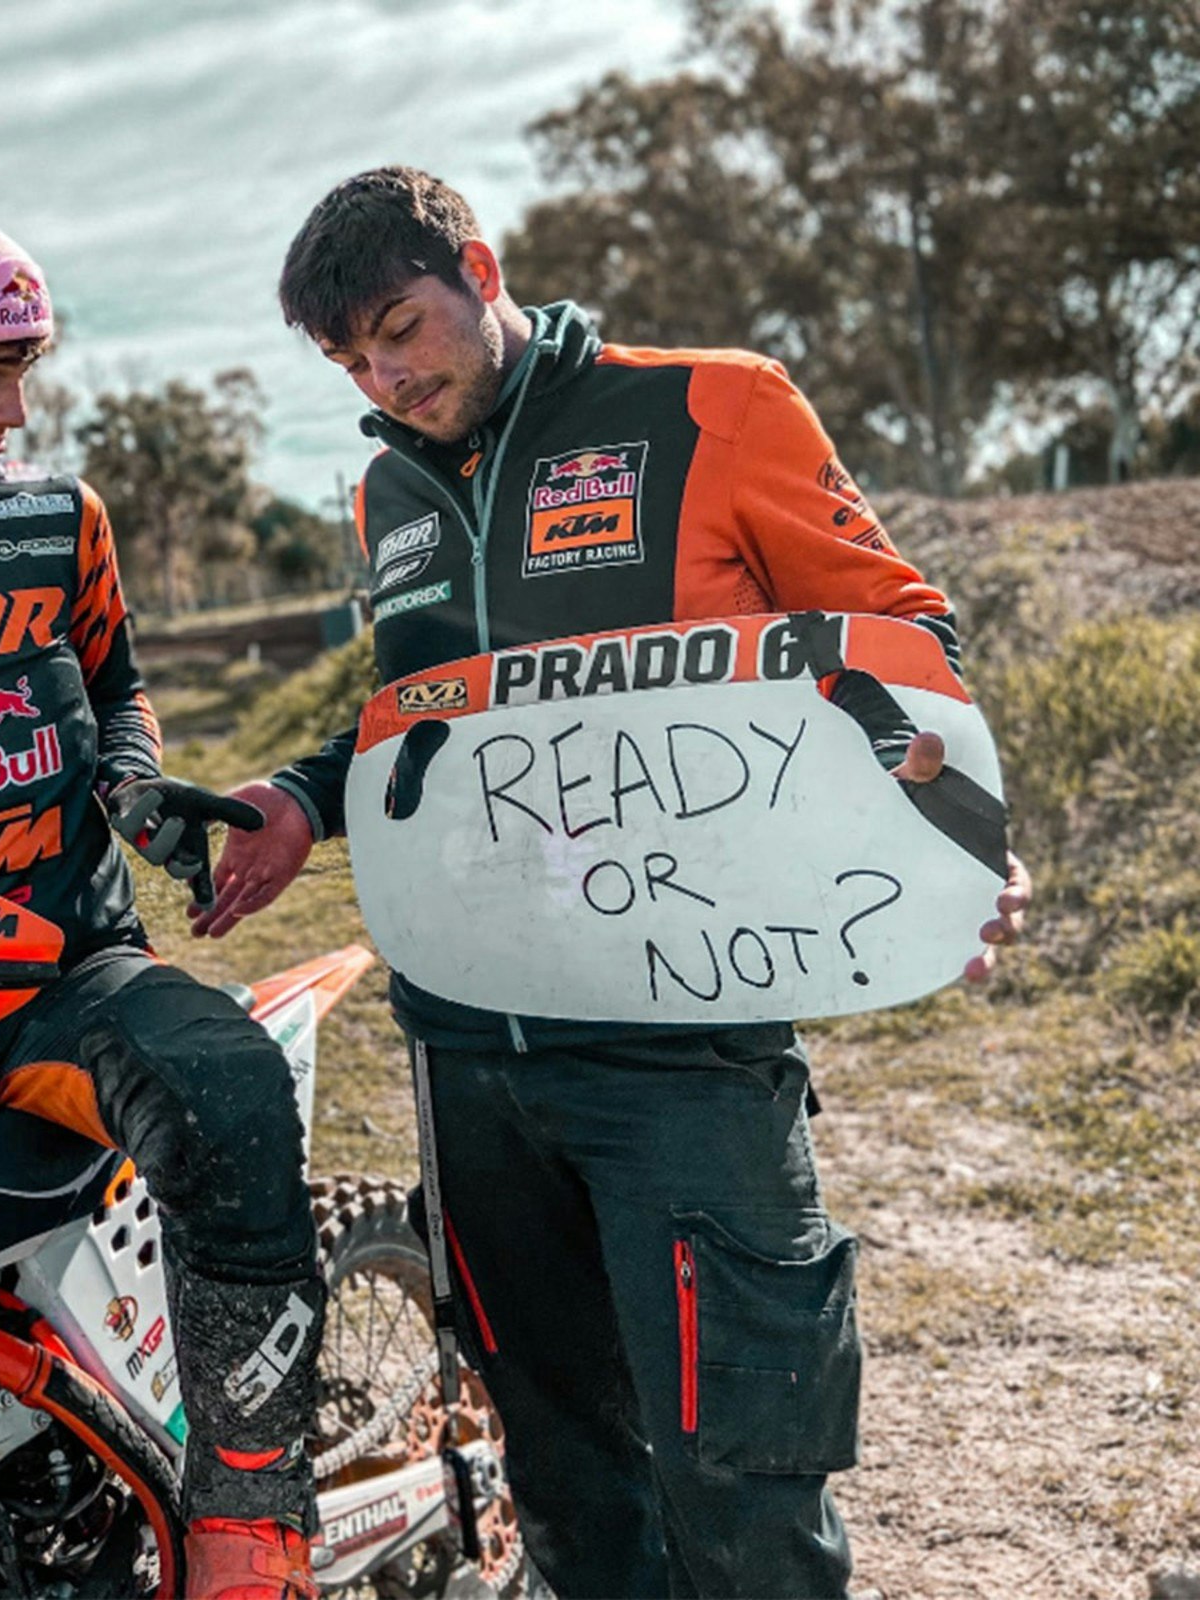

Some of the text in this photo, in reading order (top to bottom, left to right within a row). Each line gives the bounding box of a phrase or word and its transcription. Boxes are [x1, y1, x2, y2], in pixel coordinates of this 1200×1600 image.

[0, 306, 29, 325] Red
[533, 471, 636, 509] Red Bull
[544, 511, 621, 542] KTM
[528, 544, 637, 571] FACTORY RACING
[494, 626, 735, 706] PRADO
[472, 718, 806, 842] READY
[582, 850, 717, 916] OR
[323, 1494, 407, 1548] ENTHAL
